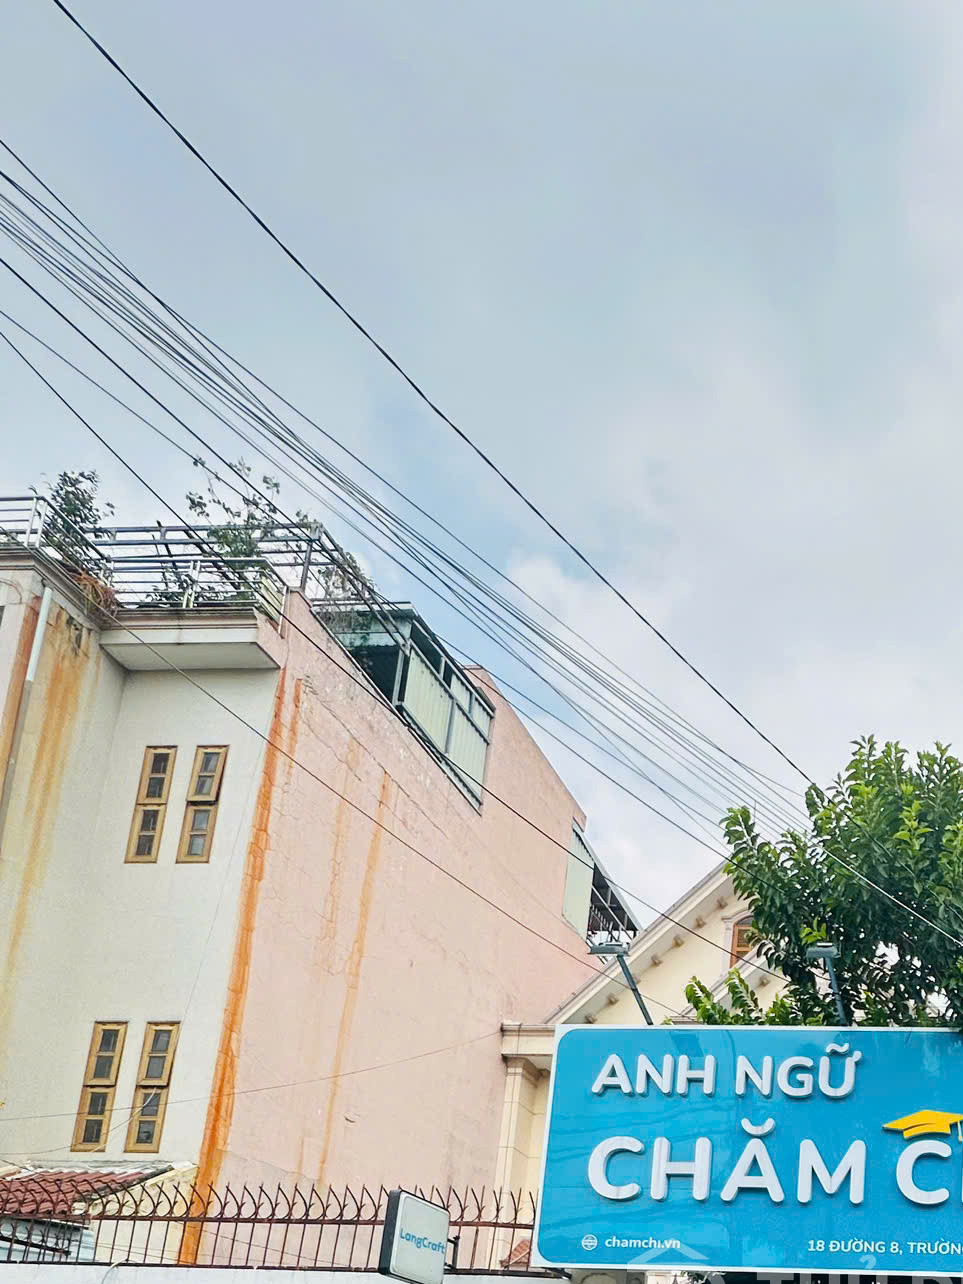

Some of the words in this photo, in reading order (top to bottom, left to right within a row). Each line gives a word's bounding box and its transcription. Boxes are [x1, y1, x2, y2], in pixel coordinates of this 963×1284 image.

[591, 1053, 717, 1097] ANH
[735, 1042, 862, 1100] NGỮ
[587, 1117, 866, 1204] CHĂM
[400, 1228, 445, 1254] LangCraft
[807, 1240, 825, 1252] 18
[829, 1237, 886, 1253] ĐƯỜNG
[890, 1242, 903, 1255] 8,
